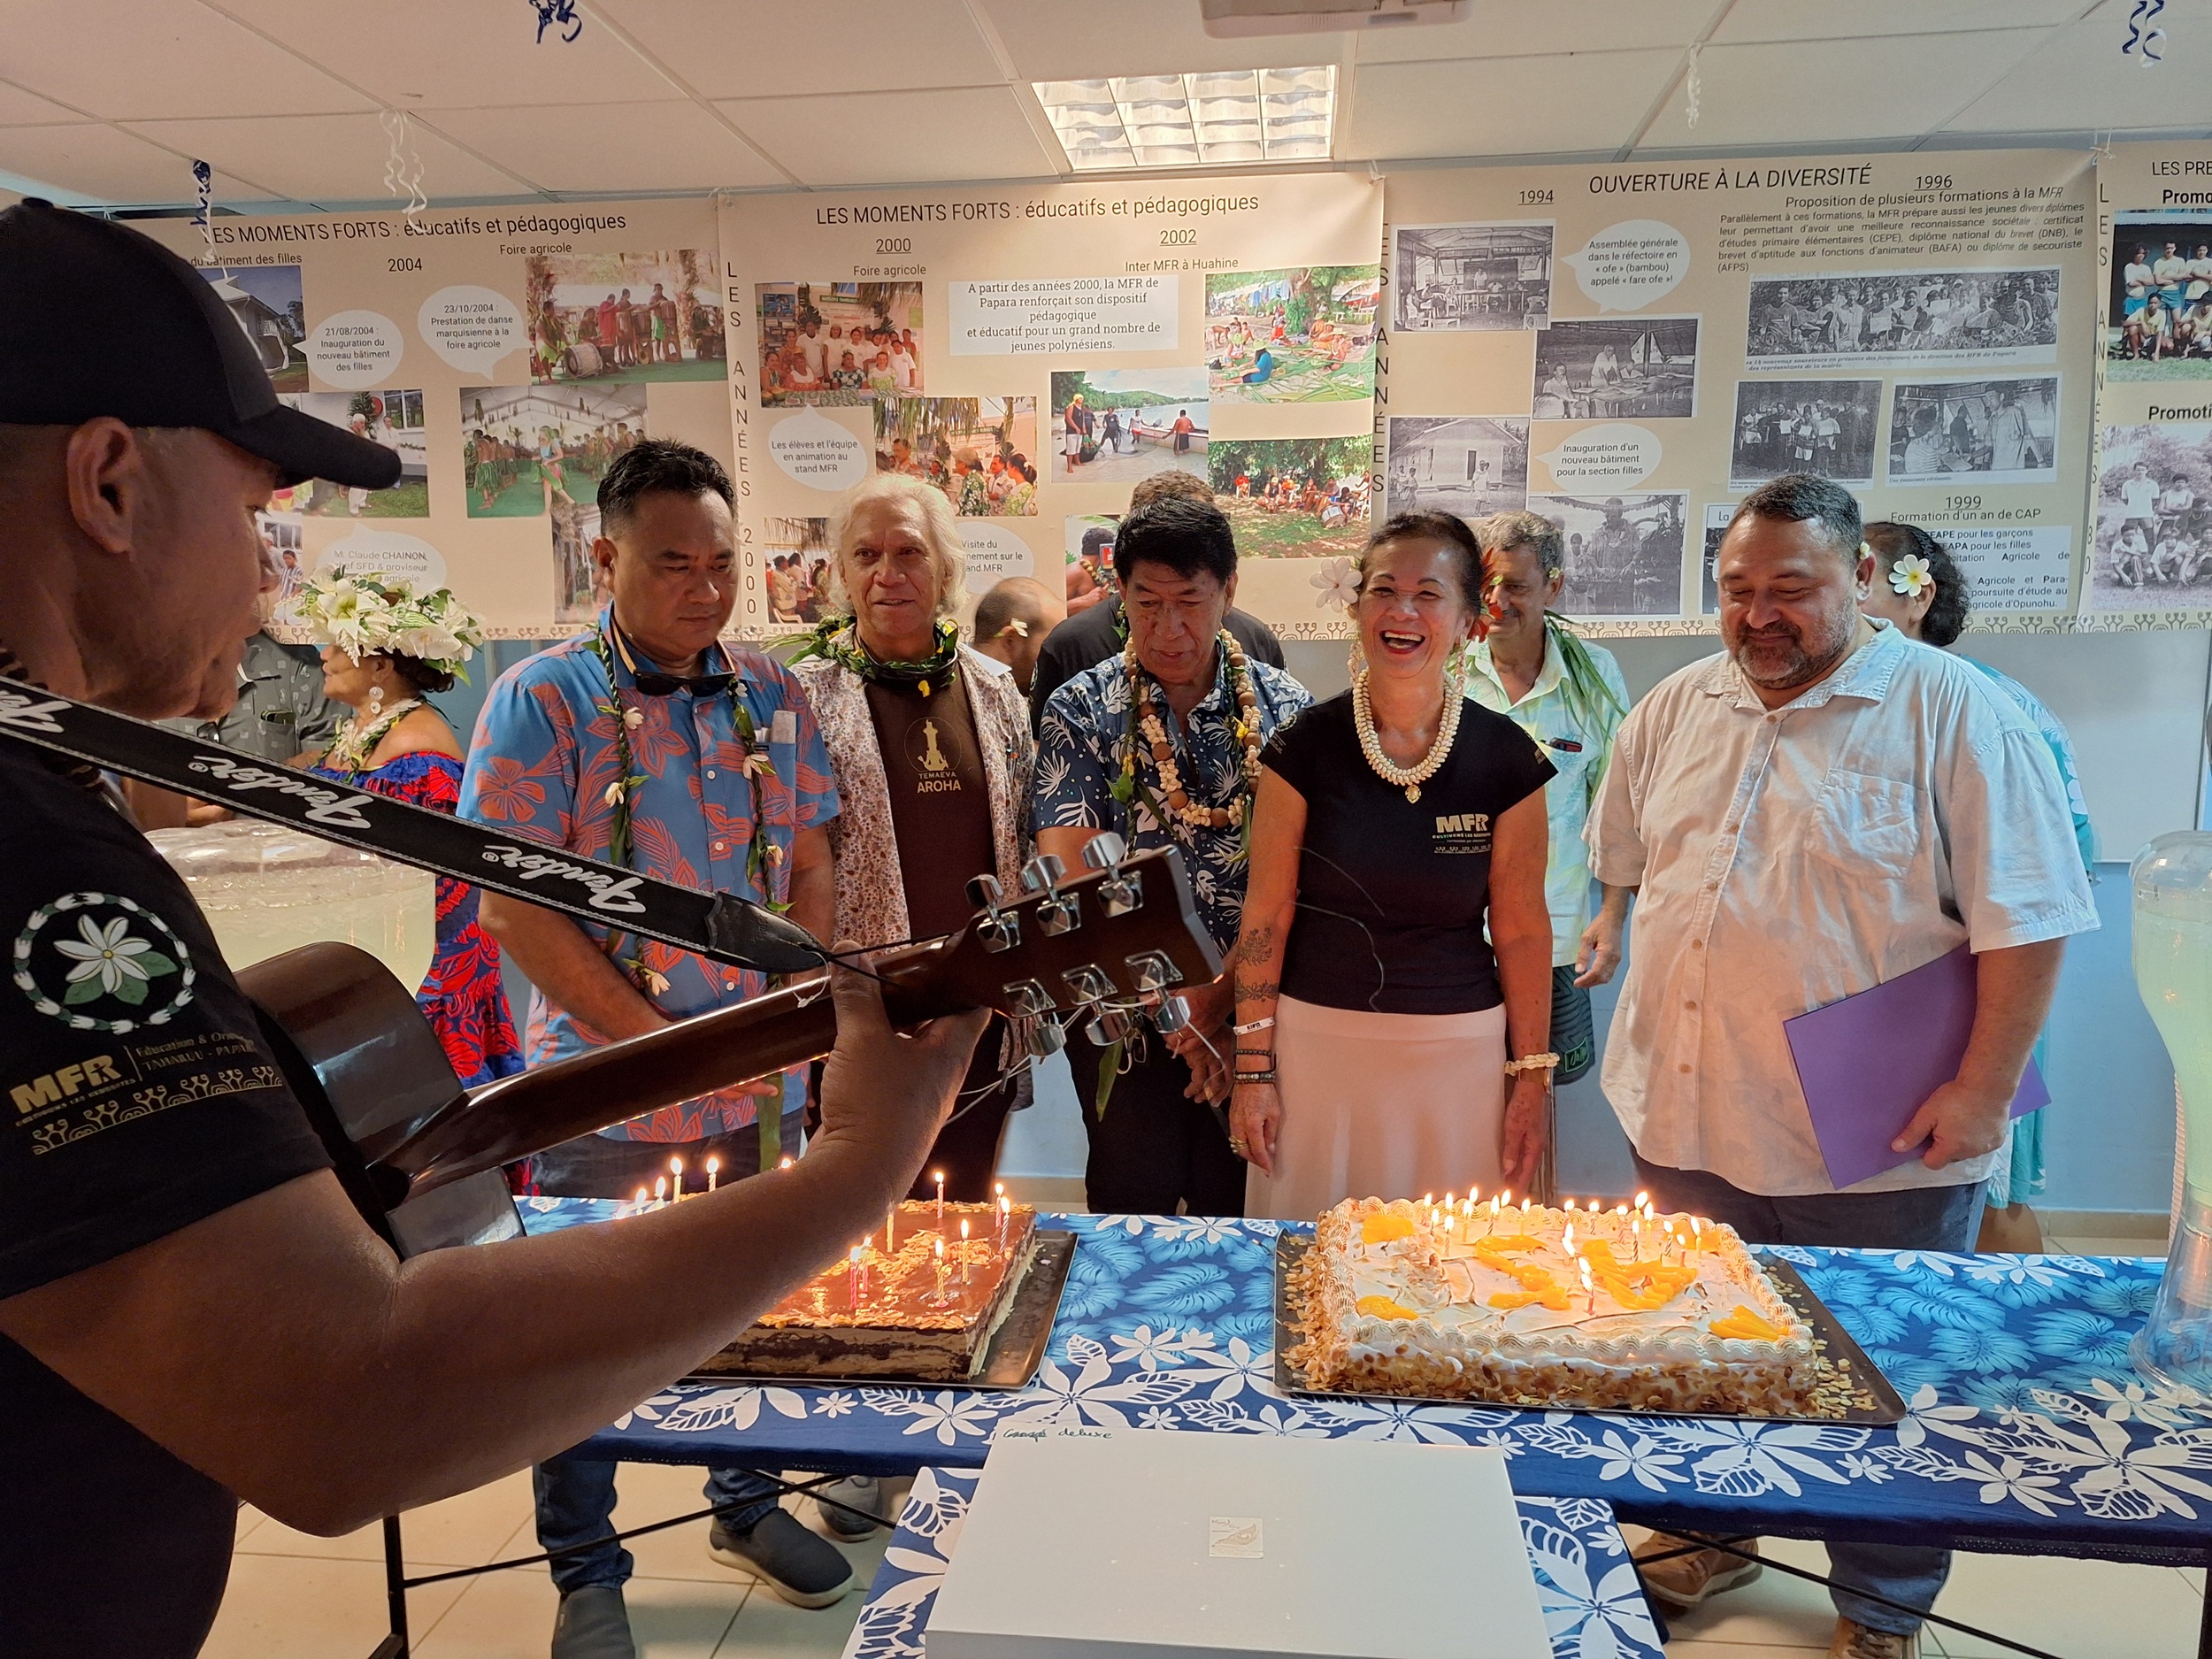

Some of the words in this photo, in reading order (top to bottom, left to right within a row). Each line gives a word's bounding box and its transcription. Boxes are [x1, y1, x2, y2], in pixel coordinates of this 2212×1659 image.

[2153, 161, 2179, 175] LES
[1590, 173, 1709, 193] OUVERTURE
[1715, 168, 1728, 188] À
[1736, 171, 1759, 188] LA
[1767, 163, 1871, 187] DIVERSITÉ
[1914, 175, 1952, 191] 1996
[1520, 190, 1554, 203] 1994
[1786, 196, 1855, 210] Proposition
[1860, 194, 1874, 205] de
[1878, 193, 1934, 207] plusieurs
[1938, 188, 2008, 202] formations
[2024, 188, 2034, 198] la
[2039, 187, 2063, 198] MFR
[818, 208, 848, 224] LES
[854, 204, 946, 223] MOMENTS
[953, 203, 1010, 220] FORTS
[1025, 198, 1105, 218] éducatifs
[1112, 200, 1127, 214] et
[1134, 195, 1258, 218] pédagogiques
[1721, 214, 1781, 223] Parallèlement
[1813, 211, 1863, 220] formations,
[1902, 208, 1938, 219] prépare
[1941, 206, 1965, 215] aussi
[1985, 205, 2016, 216] jeunes
[238, 224, 329, 242] MOMENTS
[333, 222, 390, 239] FORTS
[487, 219, 502, 233] et
[507, 214, 626, 236] pédagogiques
[1744, 226, 1793, 236] permettant
[1911, 219, 1985, 228] reconnaissance
[2044, 215, 2083, 225] certificat
[1160, 229, 1196, 243] 2002
[1763, 238, 1799, 248] primaire
[1805, 236, 1863, 245] élémentaires
[1870, 234, 1903, 244] (CEPE),
[1909, 232, 1947, 242] diplôme
[1953, 230, 1989, 239] national
[2039, 228, 2068, 239] (DNB),
[500, 245, 526, 255] Foire
[530, 242, 572, 258] agricole
[876, 238, 911, 254] 2000
[1589, 240, 1638, 249] Assemblée
[1640, 238, 1678, 250] générale
[1822, 248, 1863, 257] fonctions
[1929, 243, 1962, 254] (BAFA)
[2033, 241, 2082, 250] secouriste
[256, 254, 274, 264] des
[278, 253, 302, 263] filles
[1623, 251, 1664, 260] réfectoire
[388, 258, 422, 272] 2004
[854, 266, 879, 276] Foire
[884, 265, 926, 278] agricole
[1126, 262, 1150, 272] Inter
[1154, 260, 1179, 271] MFR
[1193, 257, 1238, 269] Huahine
[1626, 263, 1669, 273] (bambou)
[1718, 263, 1748, 273] (AFPS)
[979, 284, 1009, 296] partir
[1011, 281, 1029, 291] des
[1033, 280, 1071, 291] années
[1074, 280, 1102, 290] 2000,
[1105, 279, 1114, 288] la
[1118, 279, 1142, 288] MFR
[1146, 278, 1158, 288] de
[1591, 276, 1619, 287] appelé
[1630, 275, 1646, 284] fare
[727, 262, 741, 326] LES
[445, 304, 493, 313] 23/10/2004
[980, 298, 1016, 310] Papara
[1020, 296, 1071, 308] renforçait
[1097, 293, 1147, 306] dispositif
[1030, 310, 1096, 323] pédagogique
[326, 326, 373, 336] 21/08/2004
[437, 329, 492, 338] marquisienne
[979, 326, 1022, 337] éducatif
[1025, 328, 1048, 338] pour
[1070, 324, 1100, 337] grand
[1104, 323, 1144, 334] nombre
[1148, 322, 1160, 332] de
[321, 340, 372, 349] Inauguration
[468, 340, 500, 349] agricole
[1011, 342, 1045, 353] jeunes
[1048, 339, 1115, 352] polynésiens.
[733, 361, 750, 496] ANNÉES
[826, 440, 857, 449] l'équipe
[1564, 444, 1617, 454] Inauguration
[1947, 496, 1981, 511] 1999
[1892, 511, 1948, 522] Formation
[1953, 508, 1977, 520] d'un
[1998, 510, 2011, 519] de
[2016, 509, 2040, 518] CAP
[1996, 530, 2032, 539] garçons
[962, 540, 985, 549] Visite
[349, 550, 380, 559] Claude
[2002, 552, 2039, 562] Agricole
[743, 528, 757, 614] 2000
[1978, 576, 2015, 587] Agricole
[1970, 588, 2014, 600] poursuite
[193, 756, 373, 829] Fender
[917, 780, 961, 793] AROHA
[1435, 814, 1488, 833] MFR
[484, 845, 646, 913] Fender
[9, 1055, 122, 1115] MFR
